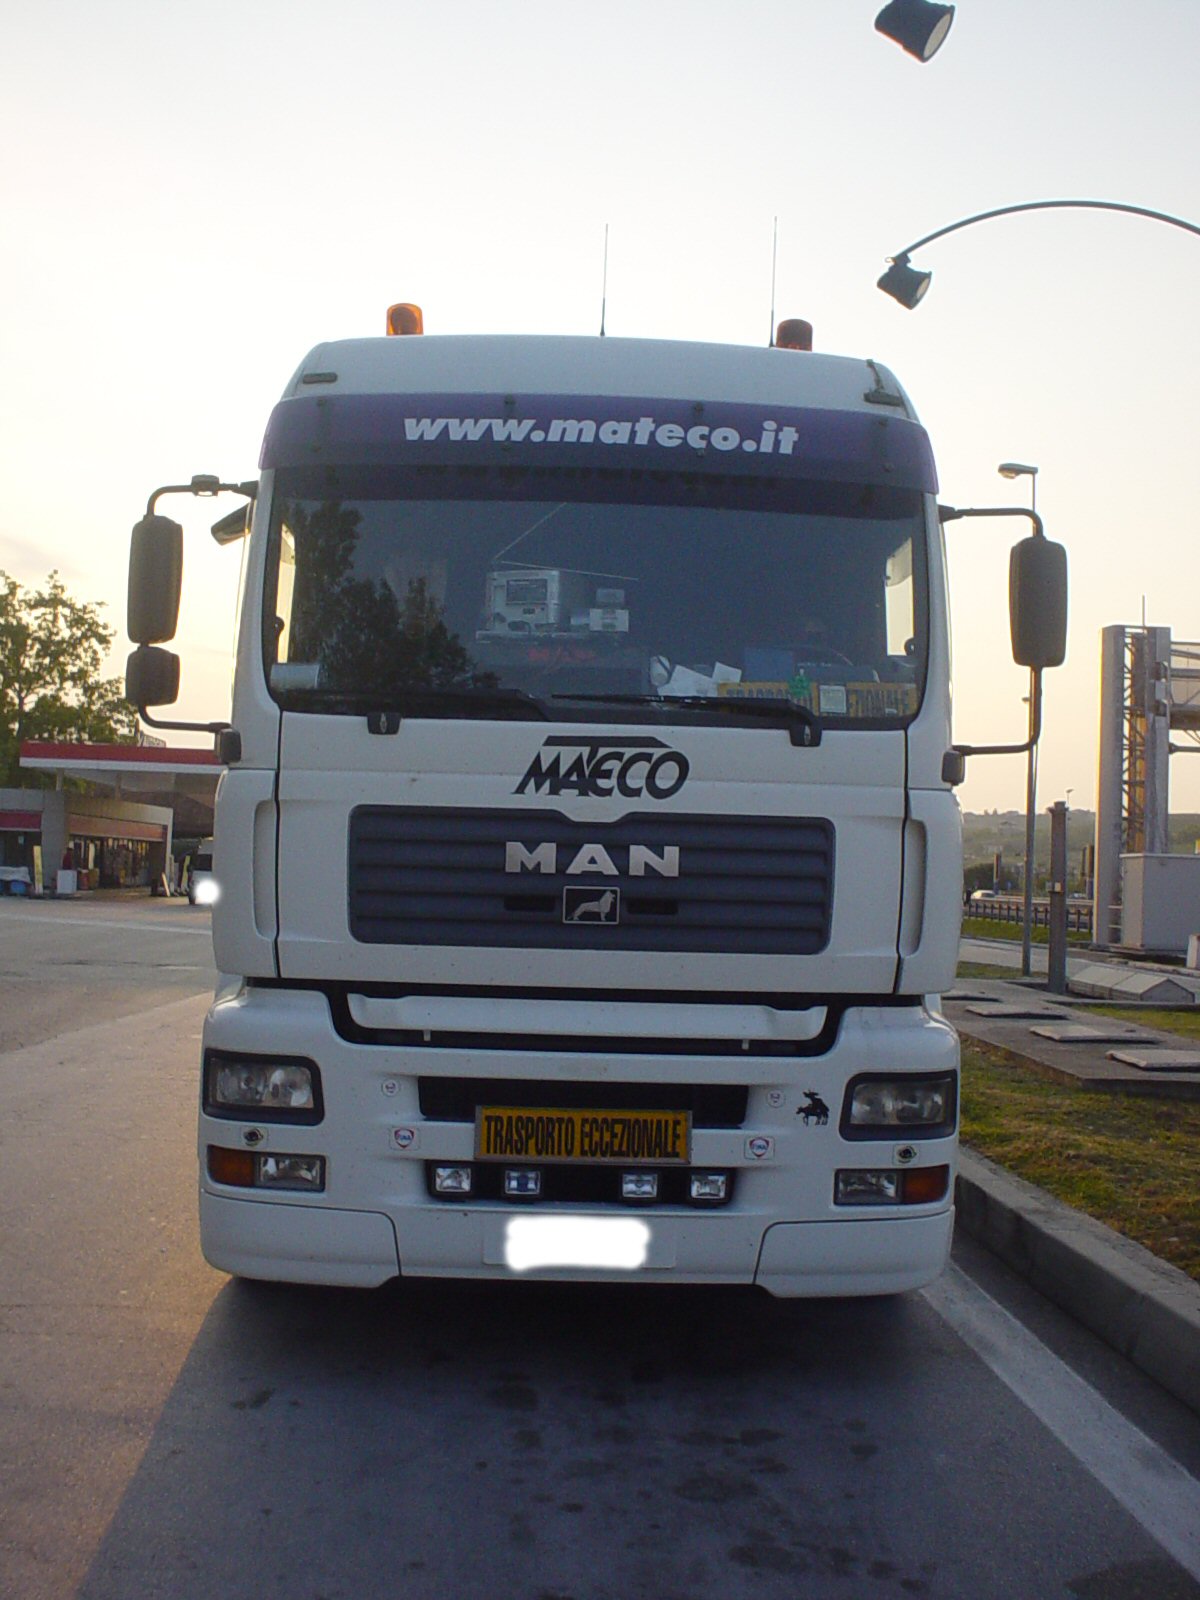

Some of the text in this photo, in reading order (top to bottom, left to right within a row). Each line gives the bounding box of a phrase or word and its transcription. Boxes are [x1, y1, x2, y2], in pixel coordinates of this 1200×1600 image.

[404, 417, 799, 455] www.mateco.it
[512, 735, 690, 800] MATECO
[504, 841, 681, 878] MAN
[485, 1114, 682, 1158] TRASPORTO ECCEZIONALE
